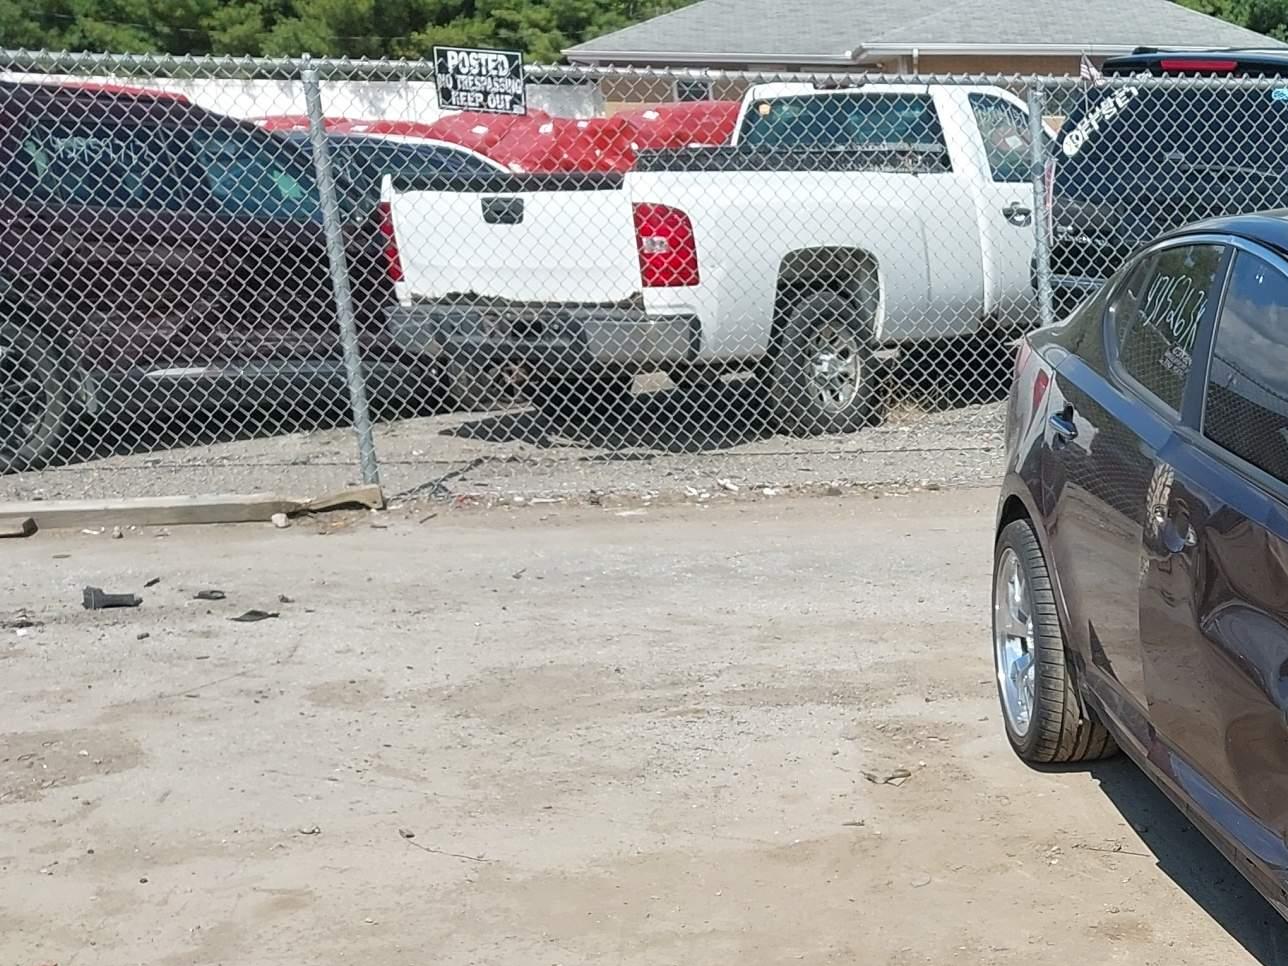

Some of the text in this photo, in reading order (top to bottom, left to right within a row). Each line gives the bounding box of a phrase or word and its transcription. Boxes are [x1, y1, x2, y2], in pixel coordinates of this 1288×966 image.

[446, 50, 510, 76] POSTED
[437, 74, 523, 95] NO TRESPASSING
[451, 91, 484, 107] KEEP
[487, 93, 513, 110] OUT
